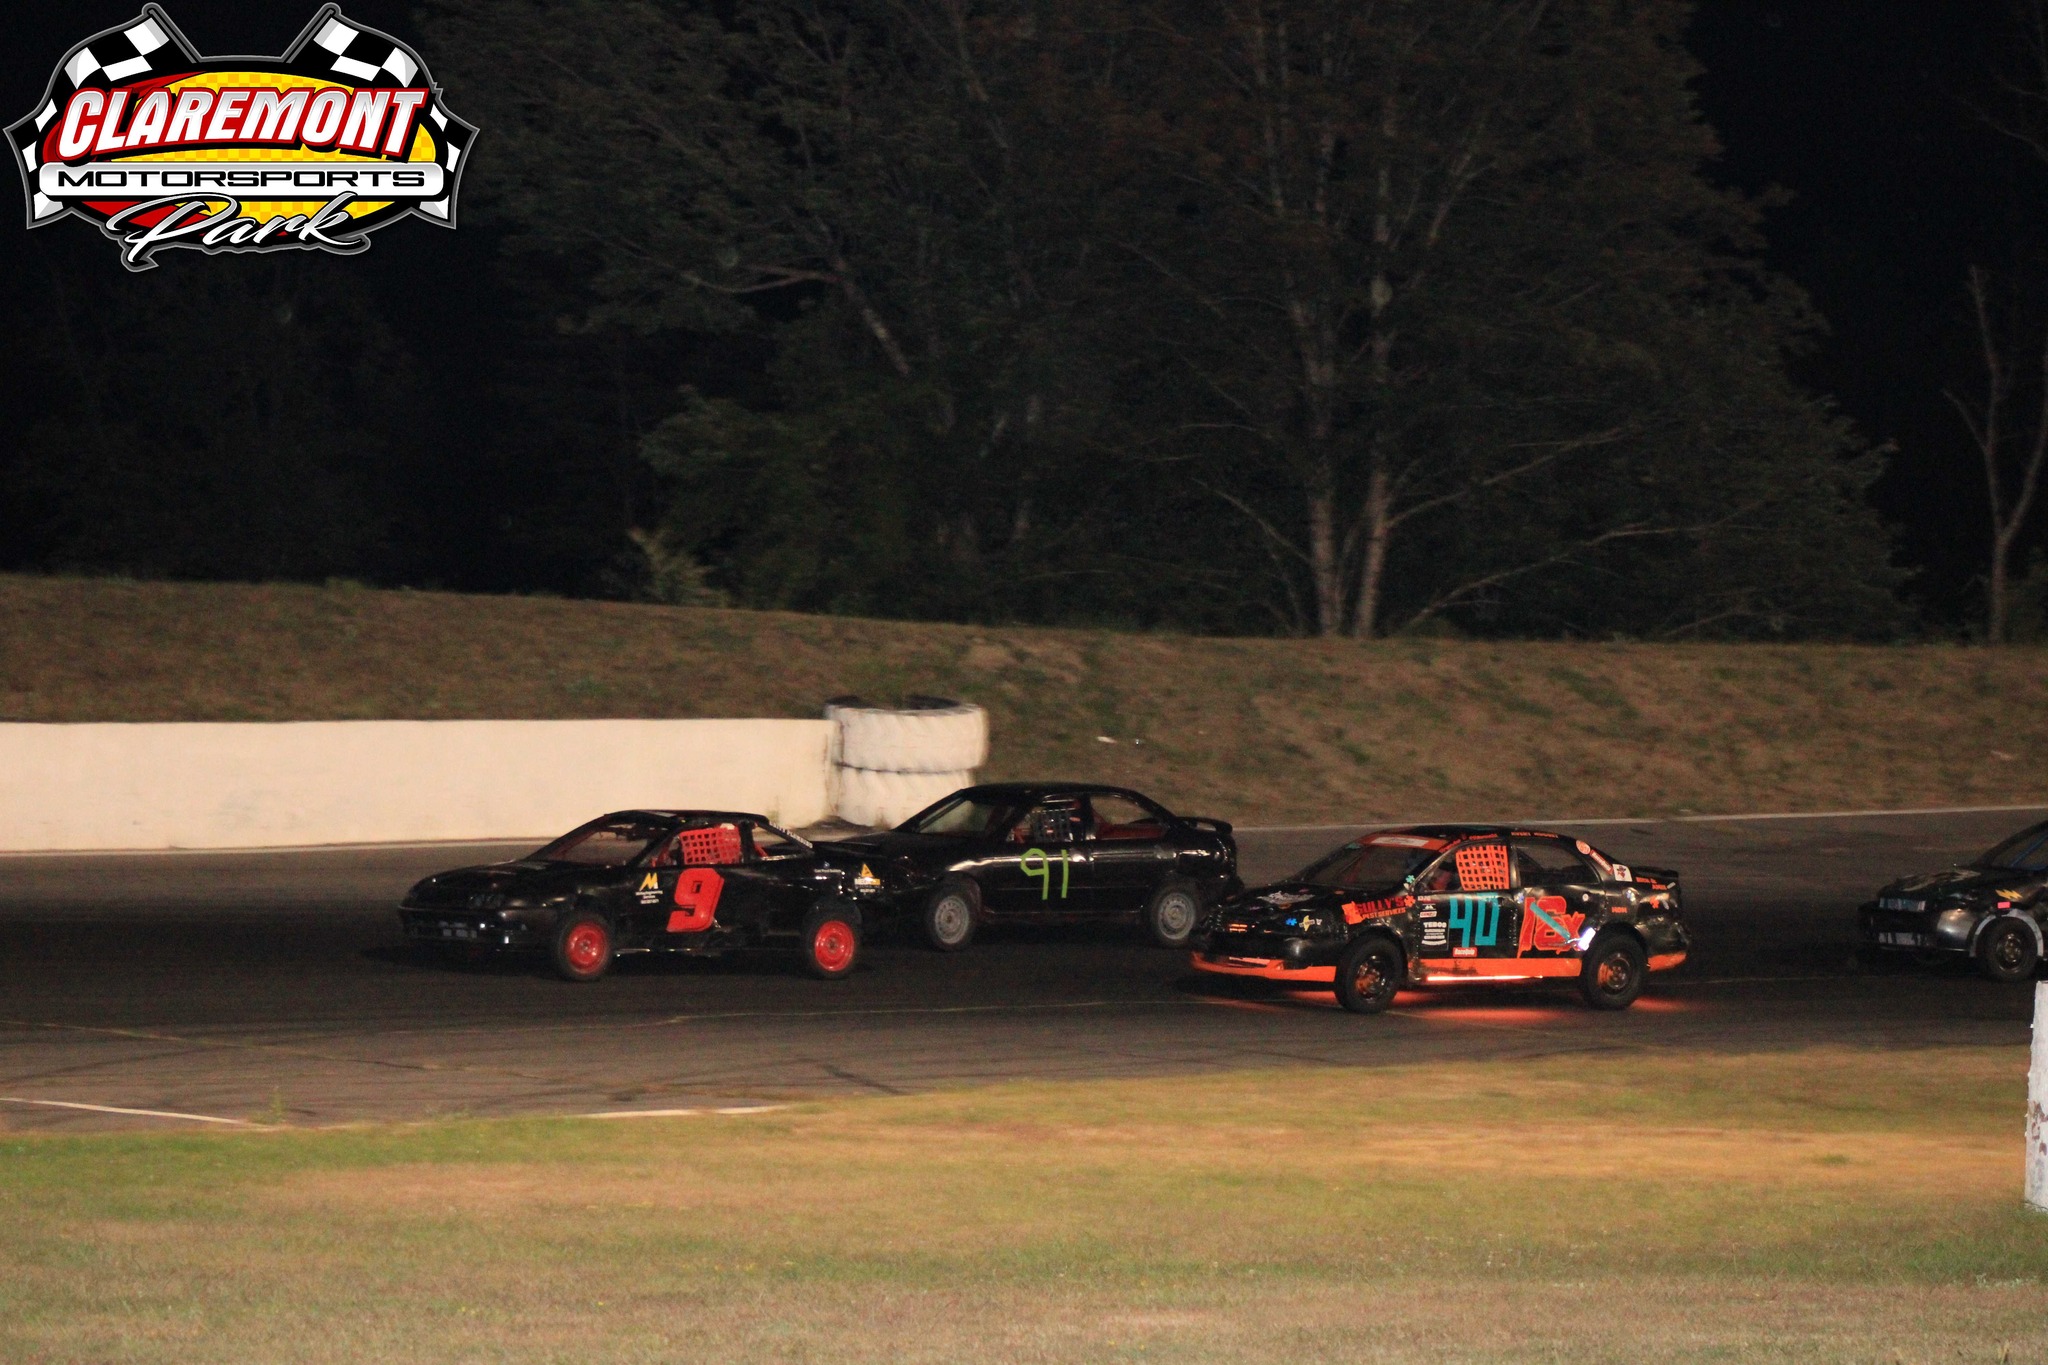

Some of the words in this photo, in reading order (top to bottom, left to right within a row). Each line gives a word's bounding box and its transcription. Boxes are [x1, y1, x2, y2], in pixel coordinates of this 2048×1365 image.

[666, 867, 725, 933] 9
[1019, 847, 1070, 901] 91
[1448, 892, 1500, 949] 40
